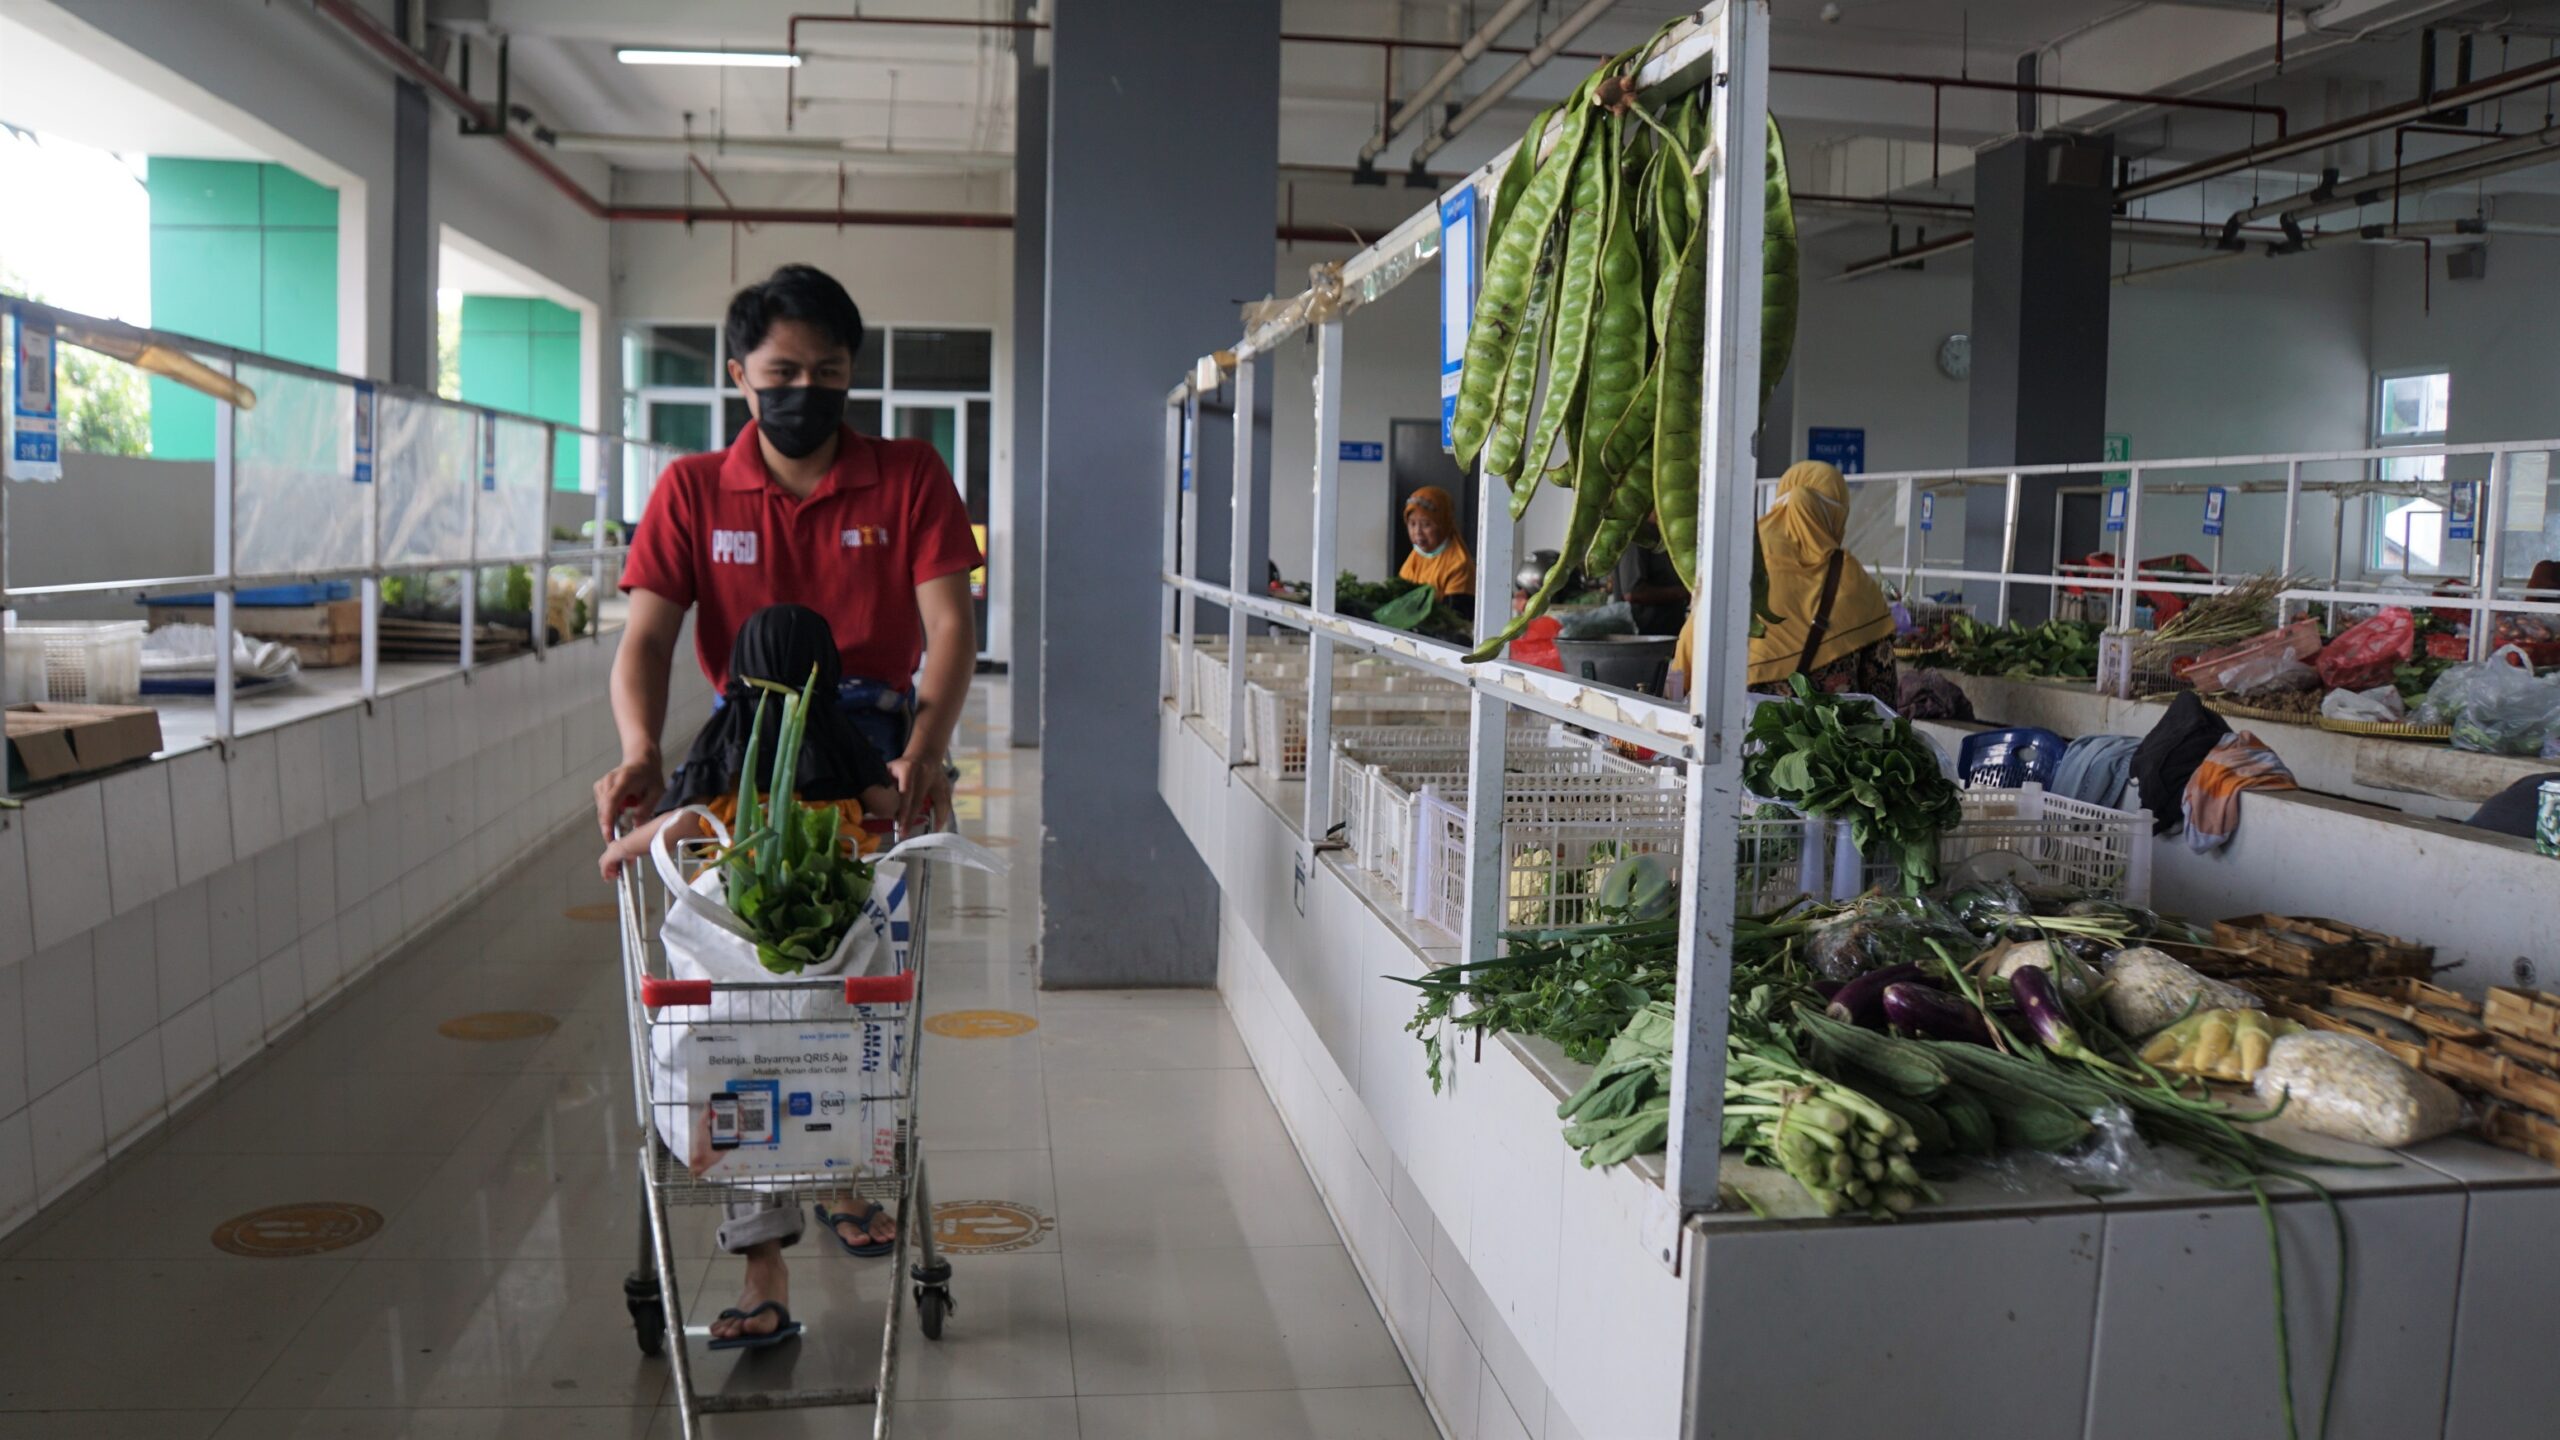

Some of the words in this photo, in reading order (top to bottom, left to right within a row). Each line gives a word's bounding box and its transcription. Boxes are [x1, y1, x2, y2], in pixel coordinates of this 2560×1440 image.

[754, 1054, 800, 1065] Bayarnya
[804, 1052, 829, 1063] QRIS
[832, 1052, 848, 1063] Aja
[784, 1067, 807, 1075] Aman
[808, 1066, 823, 1074] dan
[824, 1065, 847, 1075] Cepat
